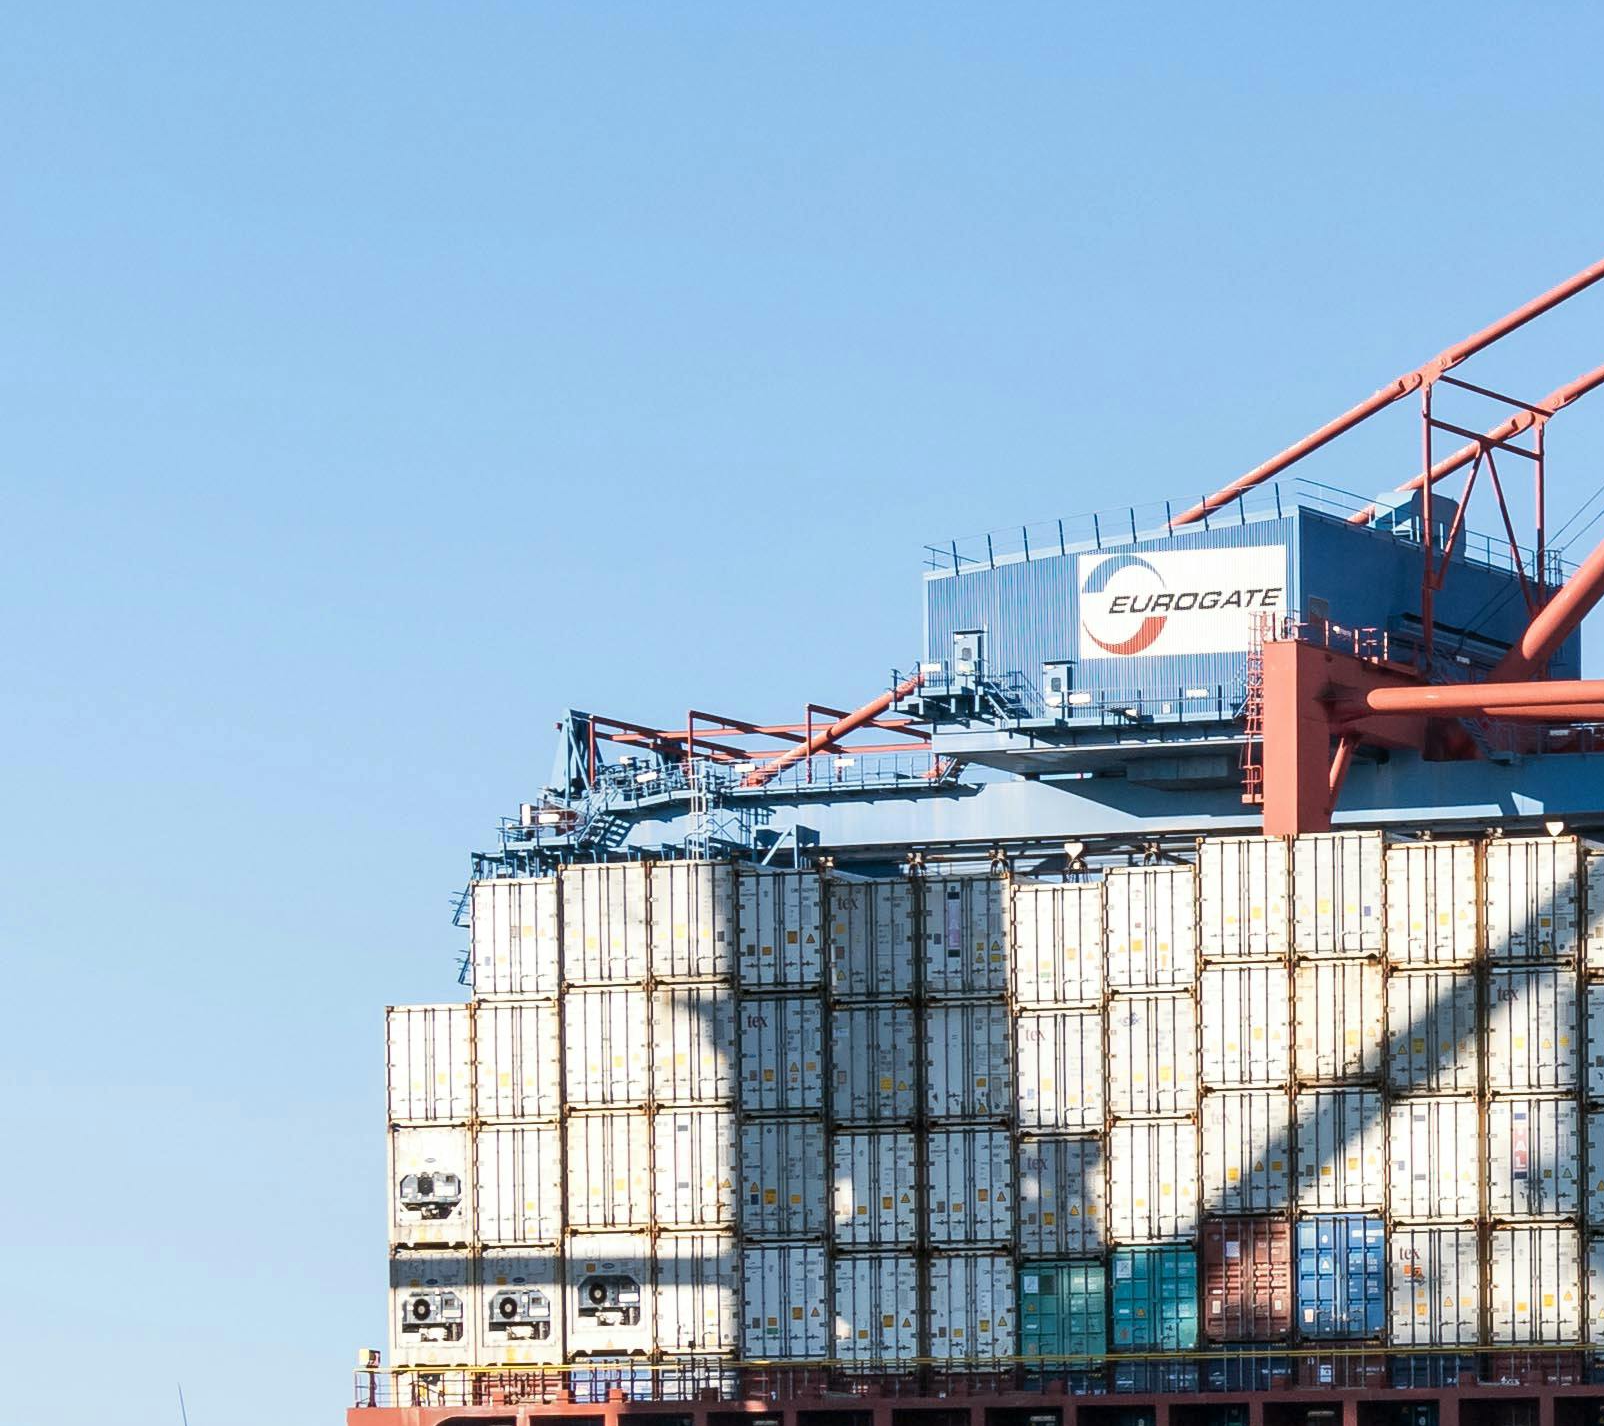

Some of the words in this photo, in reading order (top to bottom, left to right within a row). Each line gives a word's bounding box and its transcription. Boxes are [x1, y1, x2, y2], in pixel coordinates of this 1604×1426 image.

[1109, 588, 1282, 614] EUROGATE
[837, 896, 858, 911] tex
[1496, 984, 1519, 1002] tex
[746, 1014, 768, 1029] tex
[1025, 1028, 1046, 1042] tex
[1027, 1156, 1049, 1171] tex
[1398, 1245, 1421, 1260] tex
